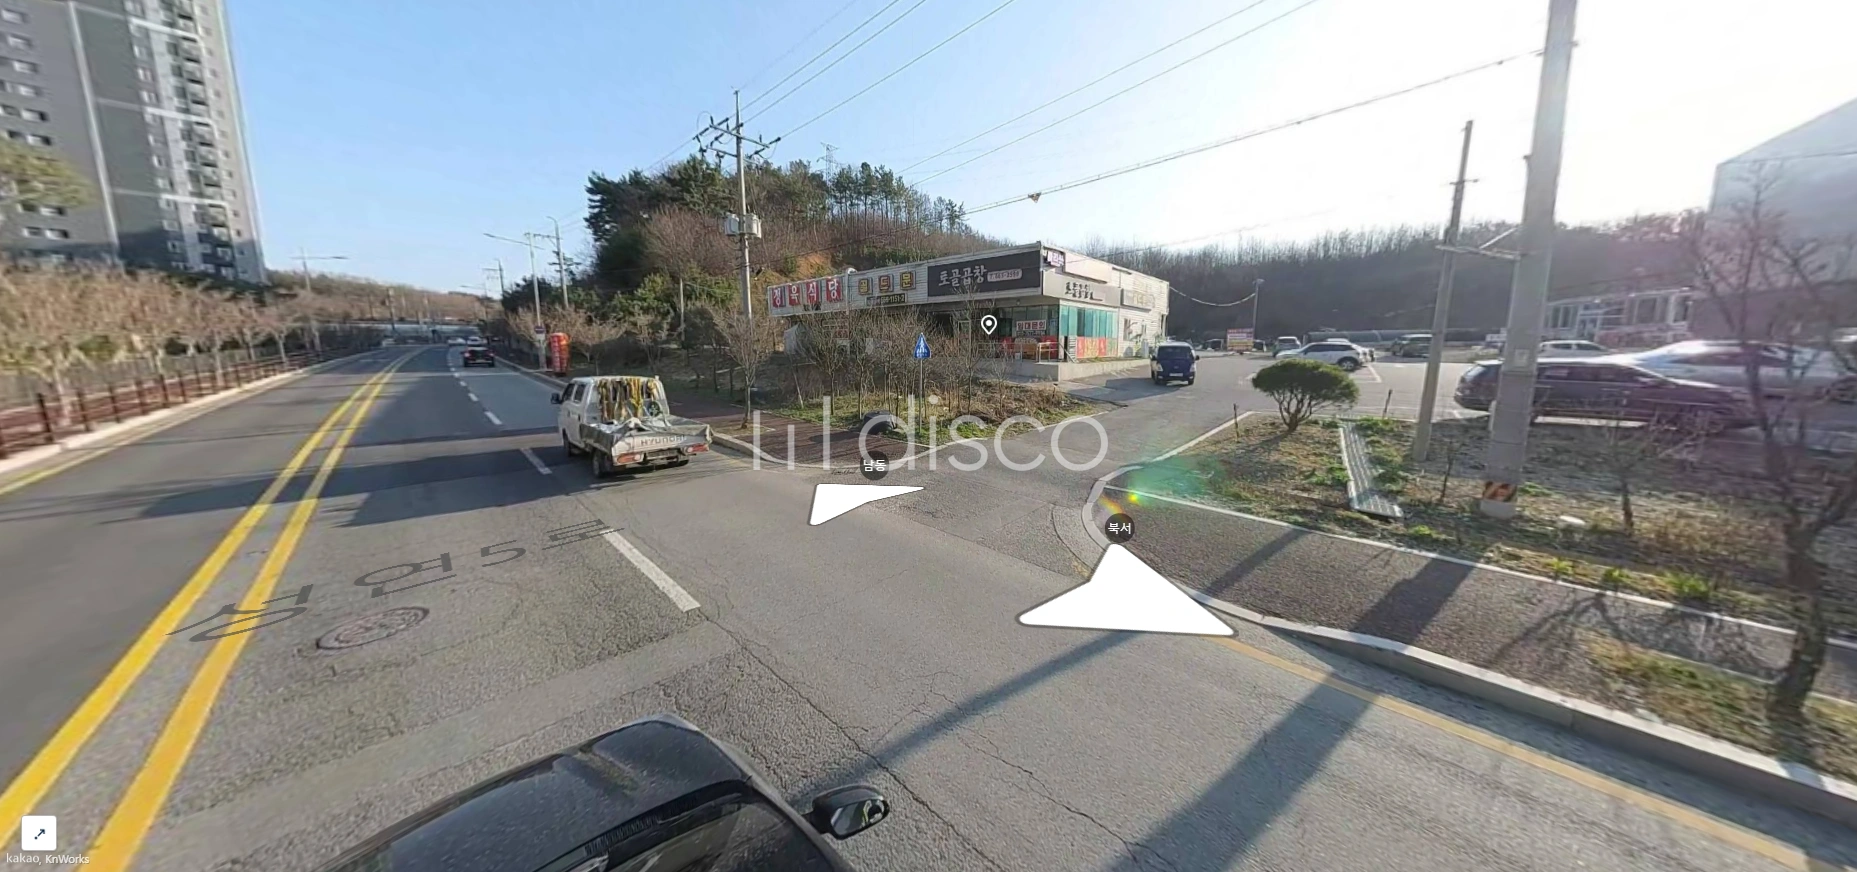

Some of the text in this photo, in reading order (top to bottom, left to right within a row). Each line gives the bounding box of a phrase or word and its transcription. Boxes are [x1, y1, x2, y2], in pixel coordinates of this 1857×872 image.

[939, 265, 987, 286] 토골곱창
[773, 279, 839, 306] 정육식당
[1018, 321, 1046, 330] 임대문의
